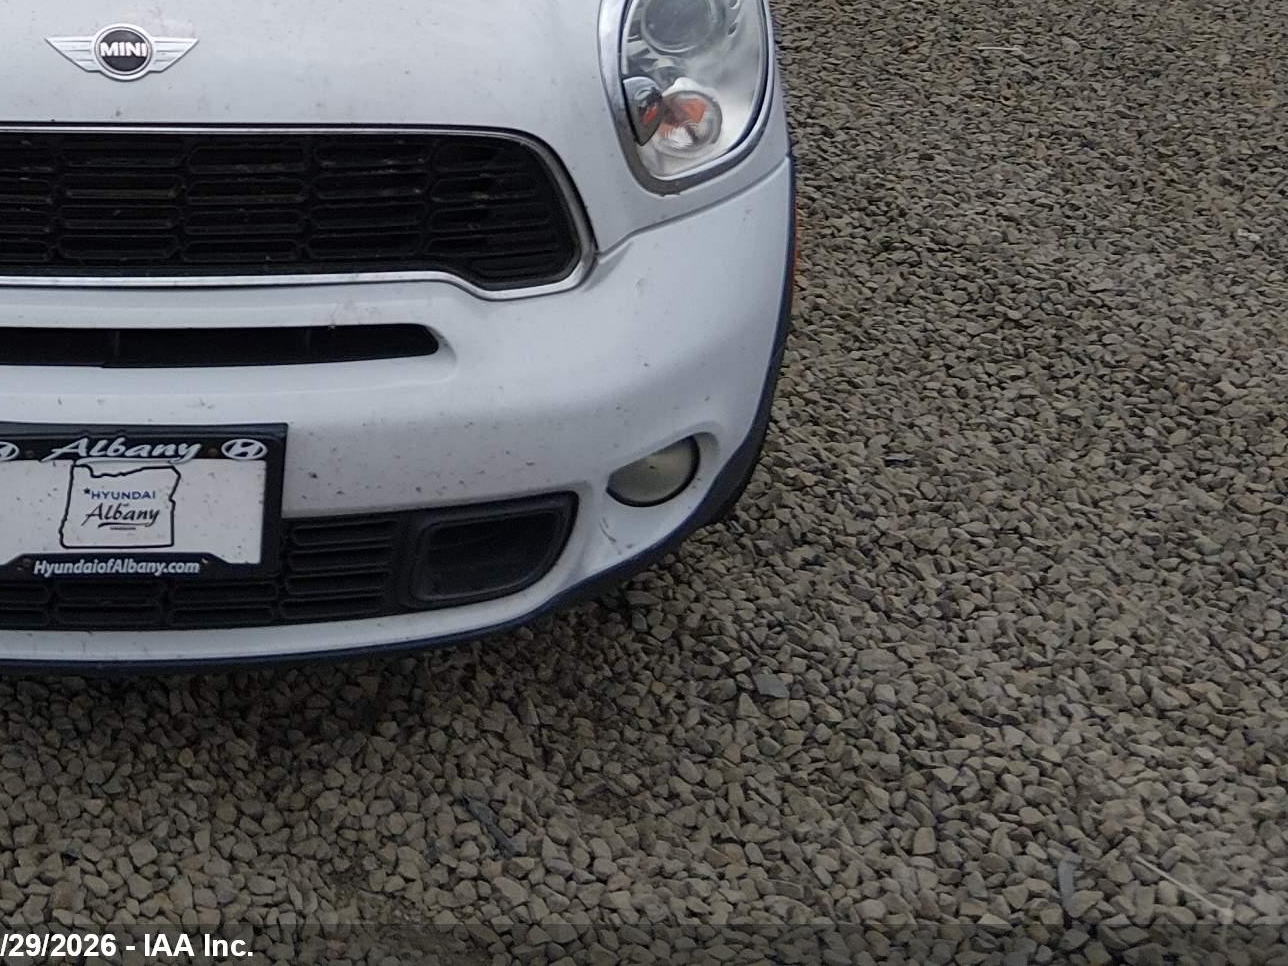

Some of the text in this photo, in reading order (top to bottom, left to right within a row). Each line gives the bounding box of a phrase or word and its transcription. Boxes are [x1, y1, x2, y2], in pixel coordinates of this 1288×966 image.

[100, 42, 147, 57] MINI
[40, 437, 201, 464] Albany
[91, 490, 156, 500] HYUNDAI
[80, 502, 160, 528] Albany
[33, 558, 200, 578] HyundaiofAlbany.com
